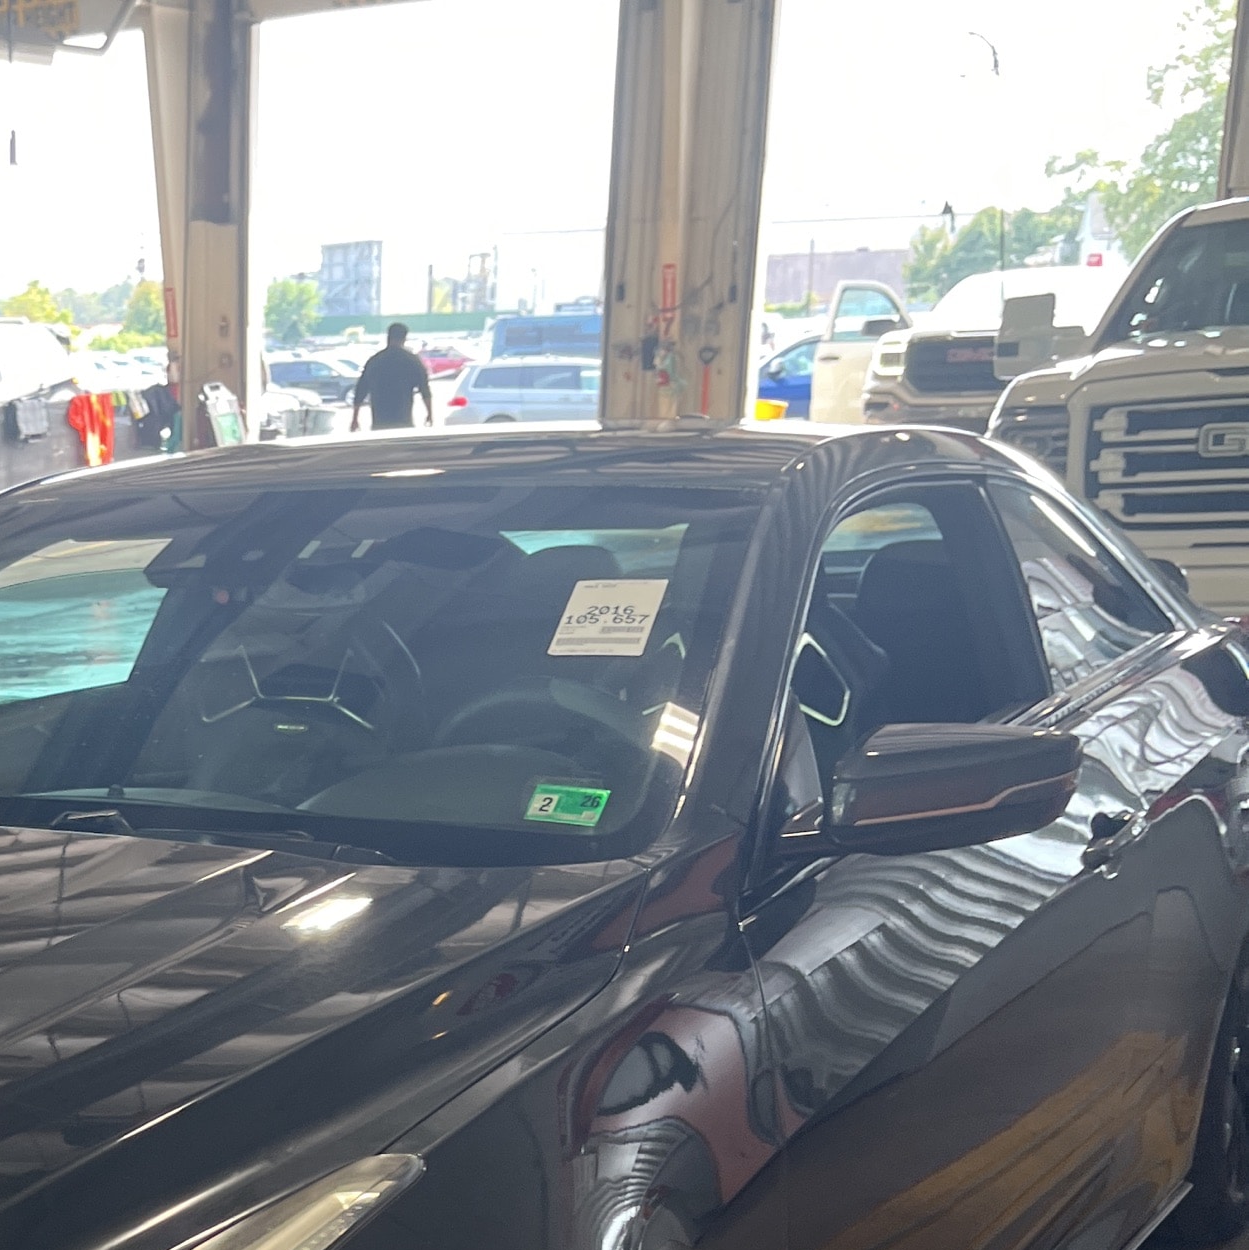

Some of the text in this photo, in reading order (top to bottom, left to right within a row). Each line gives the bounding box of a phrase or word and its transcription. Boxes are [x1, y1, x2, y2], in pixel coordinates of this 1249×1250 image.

[586, 605, 635, 615] 2016
[538, 797, 554, 812] 2
[580, 795, 602, 808] 26
